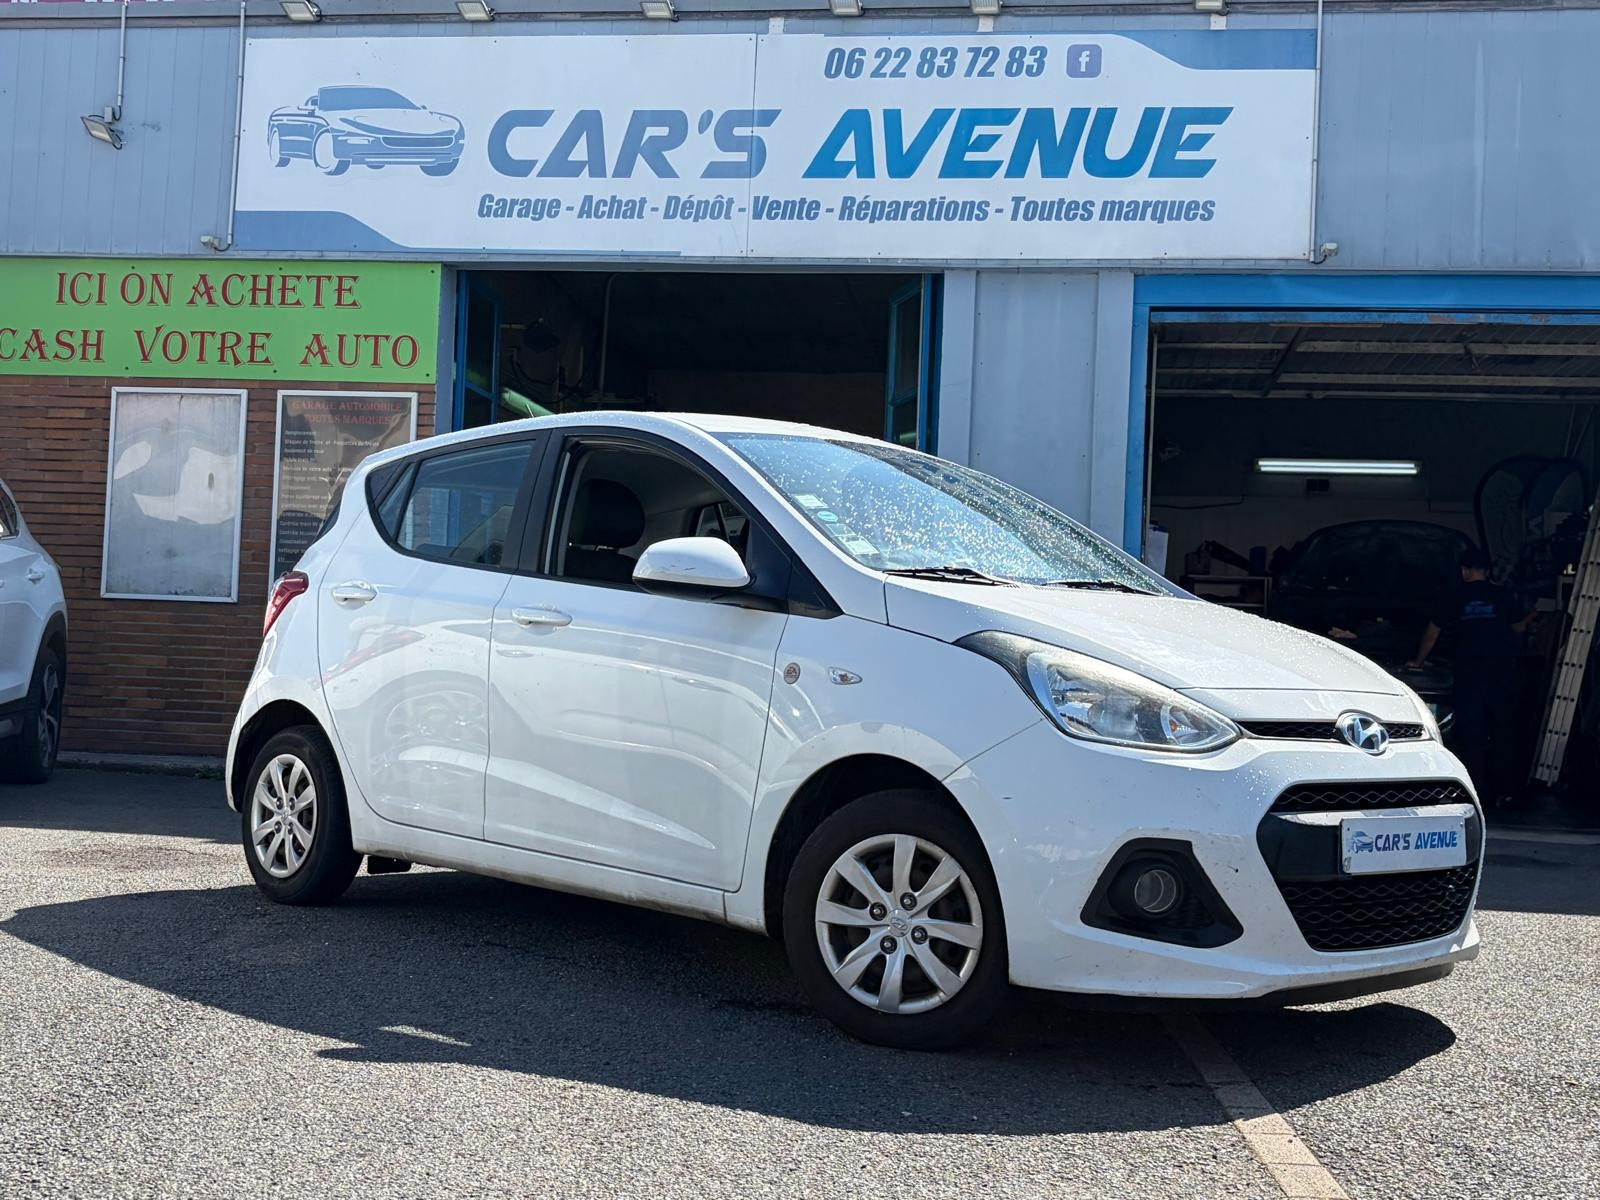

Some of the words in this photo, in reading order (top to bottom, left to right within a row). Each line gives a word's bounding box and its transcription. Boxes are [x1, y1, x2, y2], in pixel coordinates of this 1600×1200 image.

[824, 47, 866, 79] 06
[870, 47, 911, 79] 22
[916, 47, 958, 78] 83
[964, 46, 1001, 77] 72
[1005, 46, 1048, 77] 83
[488, 109, 782, 179] CAR'S
[801, 107, 1234, 179] AVENUE
[478, 194, 562, 221] Garage
[577, 195, 647, 219] Achat
[663, 195, 735, 222] Dépôt
[752, 196, 821, 221] Vente
[838, 195, 990, 224] Réparations
[1011, 196, 1095, 221] Toutes
[1099, 200, 1215, 224] marques
[56, 272, 107, 306] ICI
[120, 273, 173, 307] ON
[187, 273, 361, 309] ACHETE
[0, 328, 104, 363] CASH
[135, 325, 273, 366] VOTRE
[299, 333, 420, 368] AUTO
[1375, 833, 1411, 852] CAR'S
[1414, 830, 1458, 850] AVENUE
